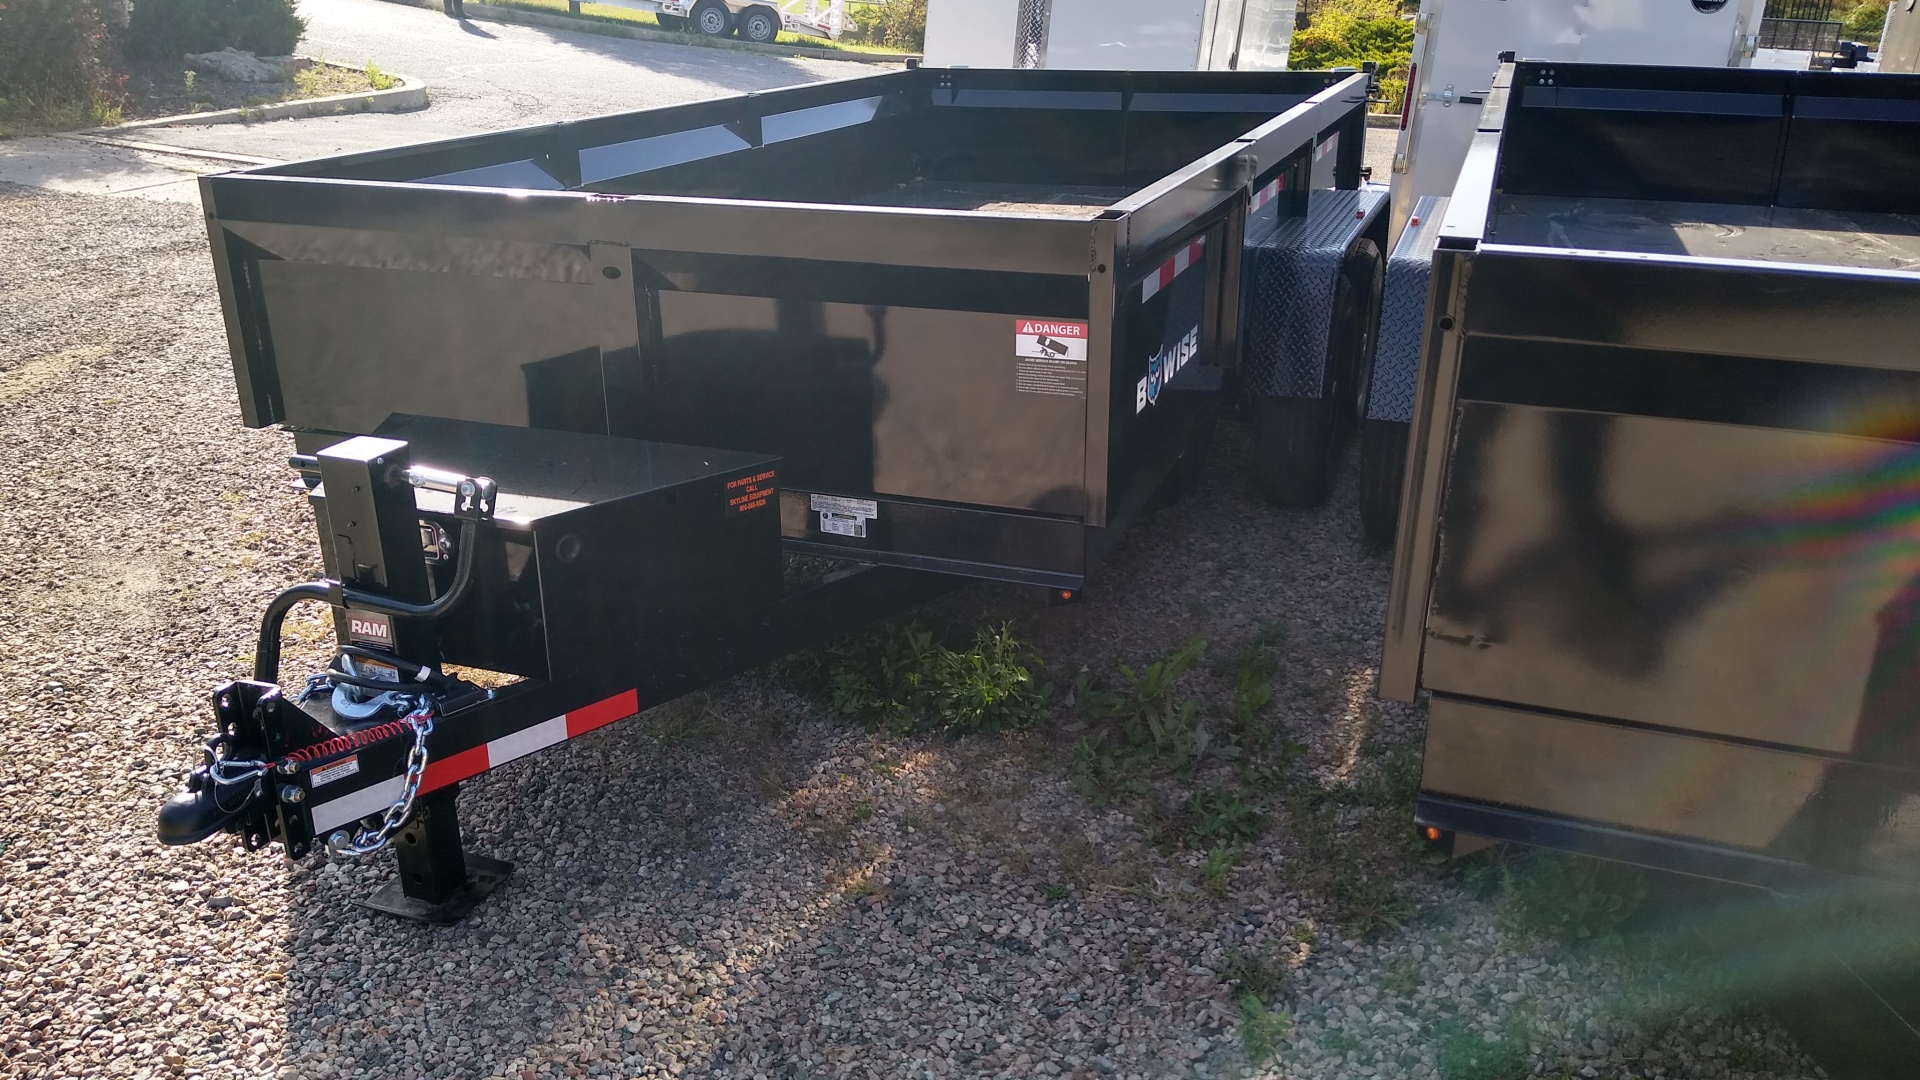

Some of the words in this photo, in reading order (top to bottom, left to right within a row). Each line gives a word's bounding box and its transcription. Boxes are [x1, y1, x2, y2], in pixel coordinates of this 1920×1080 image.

[1034, 323, 1080, 336] DANGER
[727, 481, 738, 489] FOR
[738, 477, 752, 486] PARTS
[757, 470, 775, 481] SERVICE
[730, 495, 749, 505] SKYLINE
[750, 488, 774, 500] EQUIPMENT
[351, 619, 387, 638] RAM
